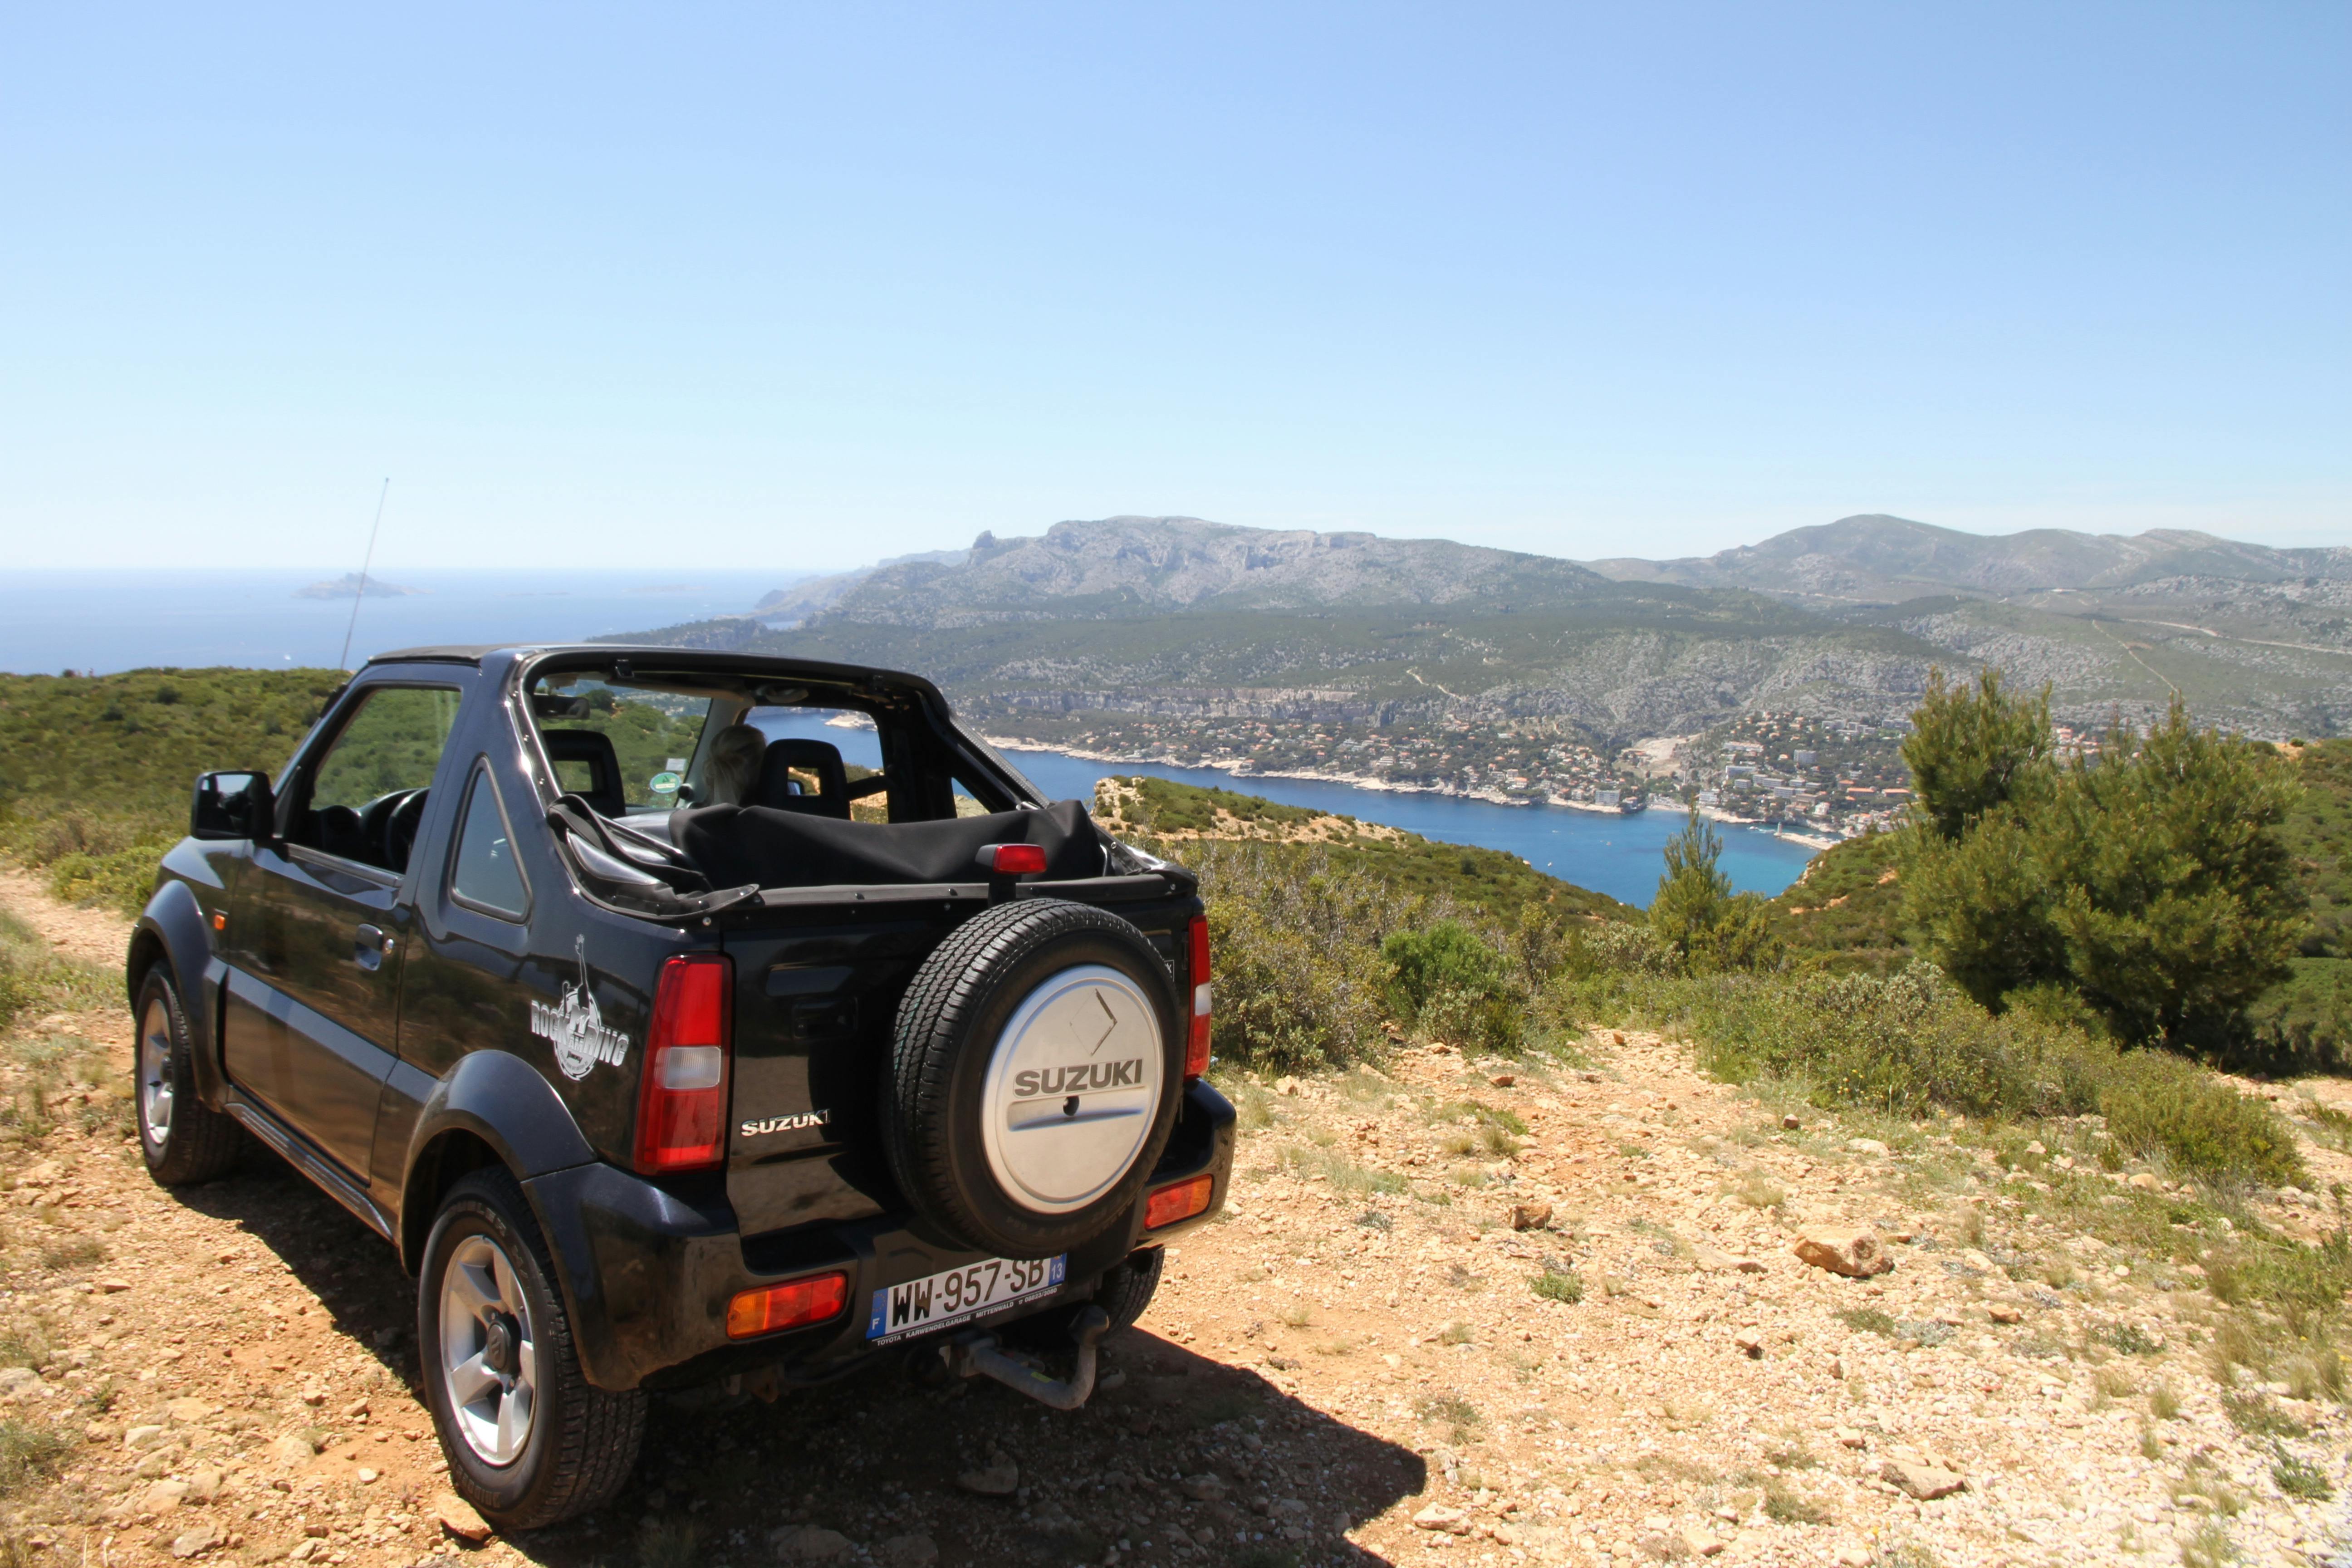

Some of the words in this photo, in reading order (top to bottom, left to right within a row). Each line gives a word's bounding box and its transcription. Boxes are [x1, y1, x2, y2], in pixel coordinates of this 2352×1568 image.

[531, 1000, 569, 1045] ROCK
[568, 1036, 584, 1053] AM
[583, 1021, 629, 1066] RING
[1014, 1059, 1142, 1097] SUZUKI
[741, 1108, 831, 1137] SUZUKI
[1051, 1263, 1063, 1279] 13
[892, 1259, 1044, 1327] WW-957-SB
[872, 1318, 880, 1330] F
[877, 1335, 901, 1346] TOYOTA
[906, 1314, 971, 1338] KARWENDELGARAGE
[976, 1301, 1014, 1318] MITTENWALD
